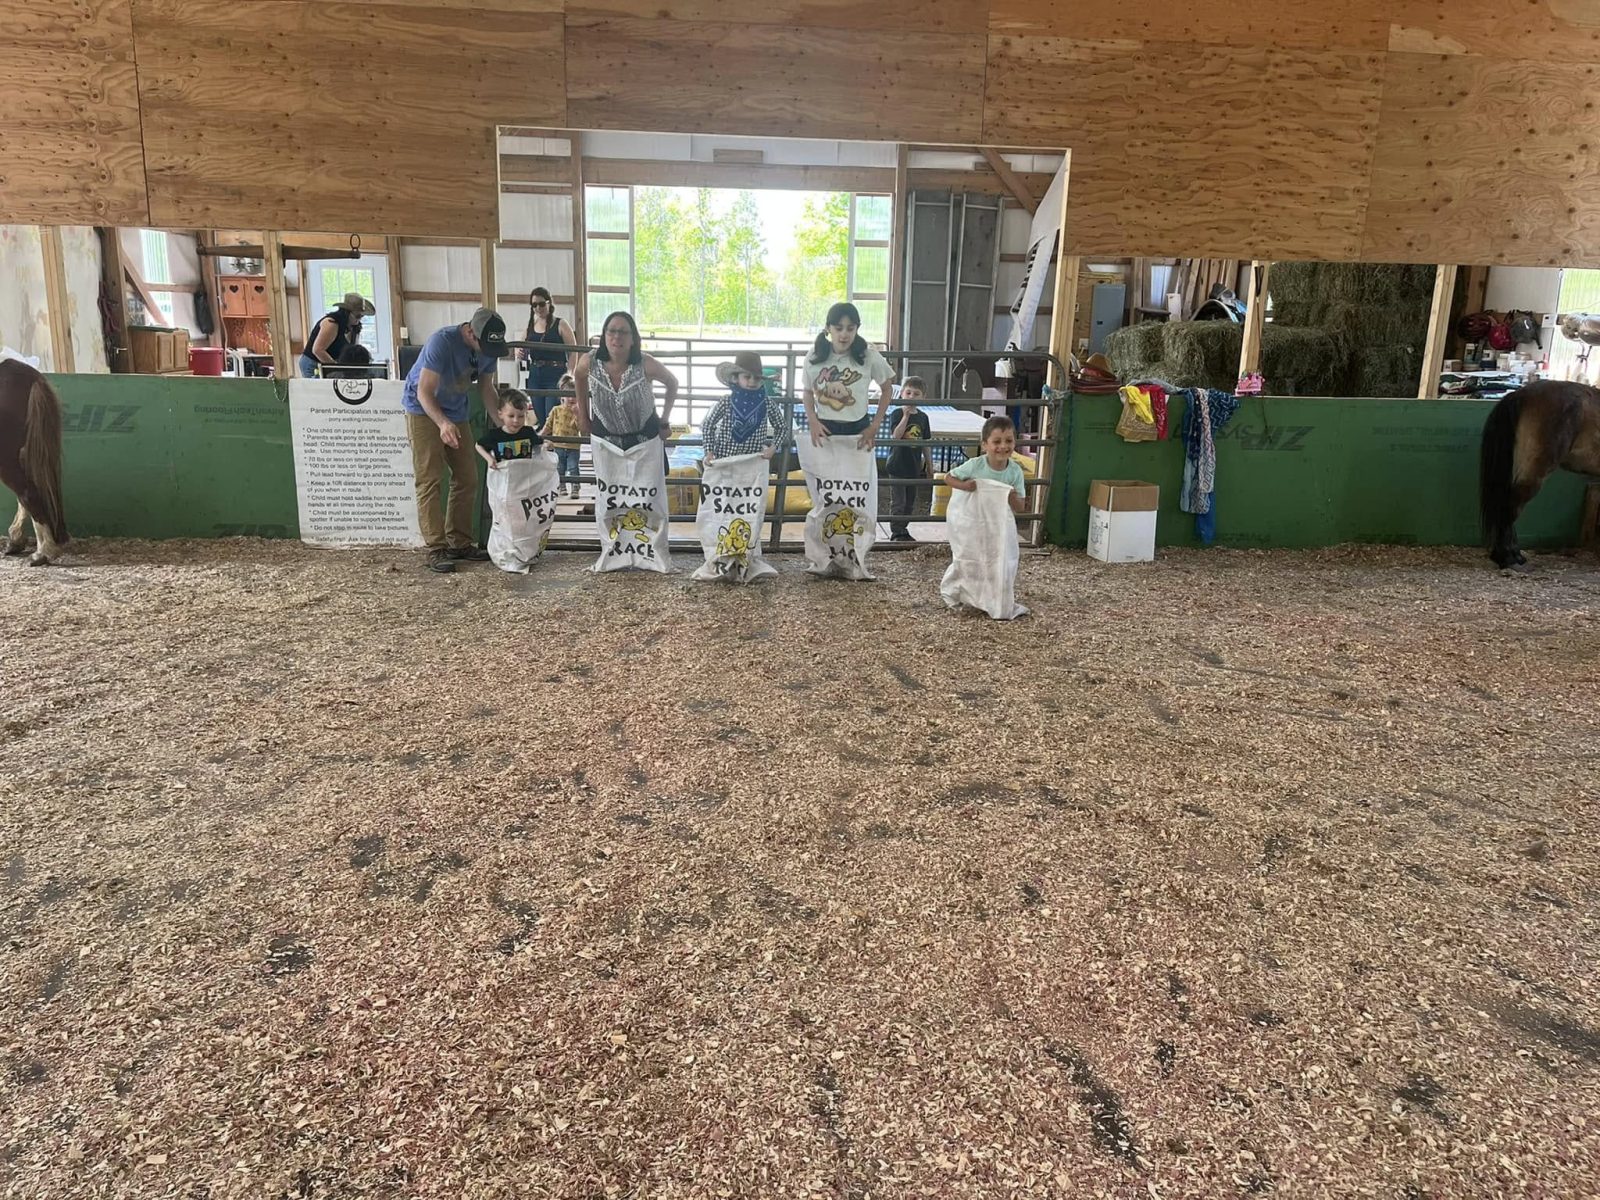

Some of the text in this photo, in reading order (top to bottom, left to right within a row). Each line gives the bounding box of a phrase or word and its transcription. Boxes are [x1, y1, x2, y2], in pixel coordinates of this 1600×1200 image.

[701, 484, 762, 504] POTATO
[824, 492, 866, 507] SACK
[607, 496, 653, 512] SACK
[714, 498, 757, 514] SACK
[608, 542, 654, 558] RACE
